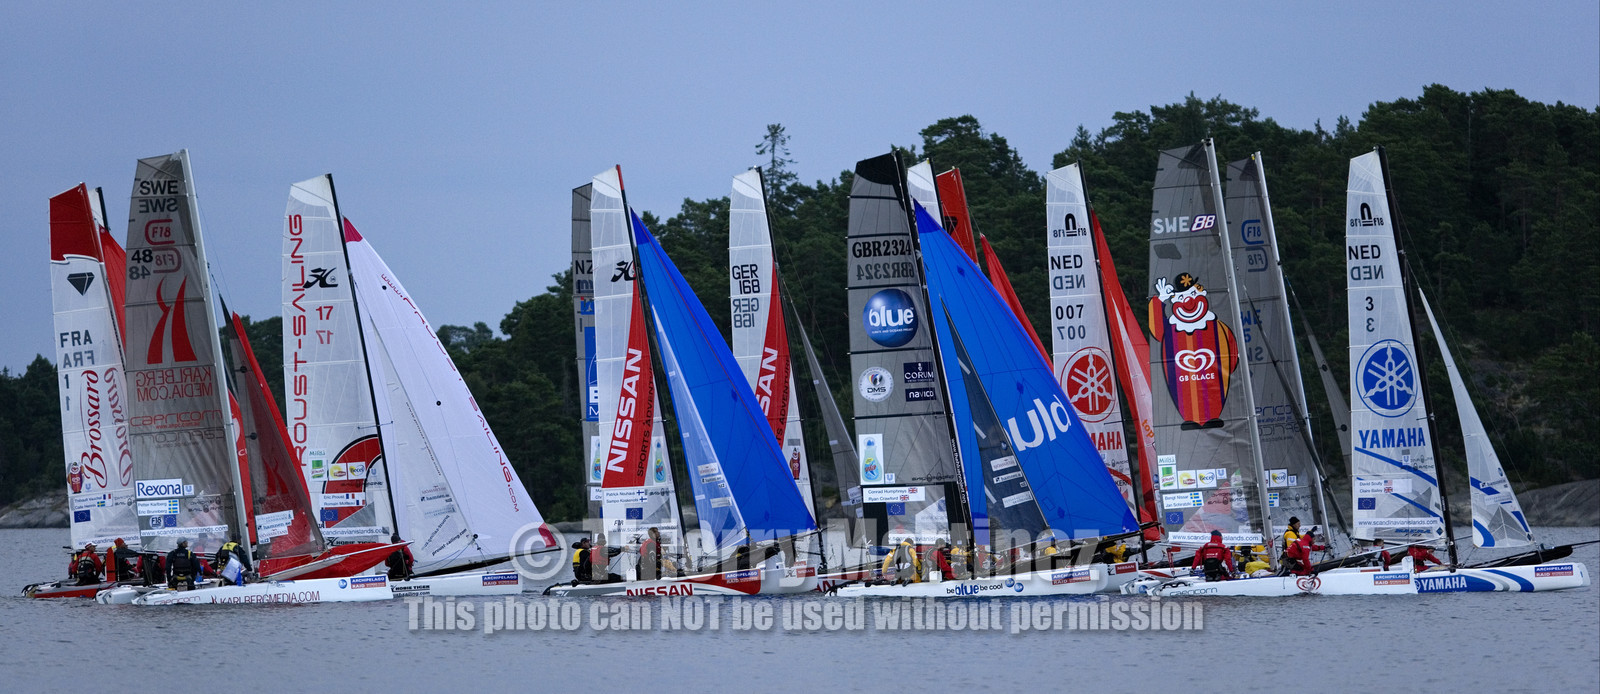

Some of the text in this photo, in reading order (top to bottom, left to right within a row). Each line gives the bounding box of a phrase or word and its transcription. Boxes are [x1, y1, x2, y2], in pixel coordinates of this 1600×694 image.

[139, 180, 178, 196] SWE
[1154, 214, 1216, 233] SWE 88
[152, 225, 171, 239] F18
[1247, 227, 1261, 237] F18
[131, 249, 153, 264] 48
[852, 240, 911, 258] GBR2324
[1348, 245, 1381, 260] NED
[1051, 254, 1082, 269] NED
[732, 264, 759, 279] GER
[739, 280, 760, 294] 168
[1365, 297, 1374, 311] 3
[315, 306, 333, 320] 17
[869, 305, 914, 327] blue
[1055, 304, 1084, 320] 007
[60, 329, 93, 348] FRA
[64, 374, 69, 389] 1
[1191, 373, 1215, 381] GLACE
[909, 390, 934, 398] navico
[607, 348, 642, 473] NISSAN
[80, 370, 107, 488] Brossard
[1141, 419, 1155, 438] top
[1358, 427, 1426, 449] YAMAHA
[637, 431, 650, 477] SPORTS
[137, 482, 181, 496] Rexona
[141, 526, 228, 537] www.scandinavianislands.com
[1053, 570, 1088, 579] ARCHIPELAGO
[626, 584, 693, 596] NISSAN
[956, 581, 979, 597] blue
[988, 583, 1003, 591] cool
[1421, 576, 1467, 591] YAMAHA
